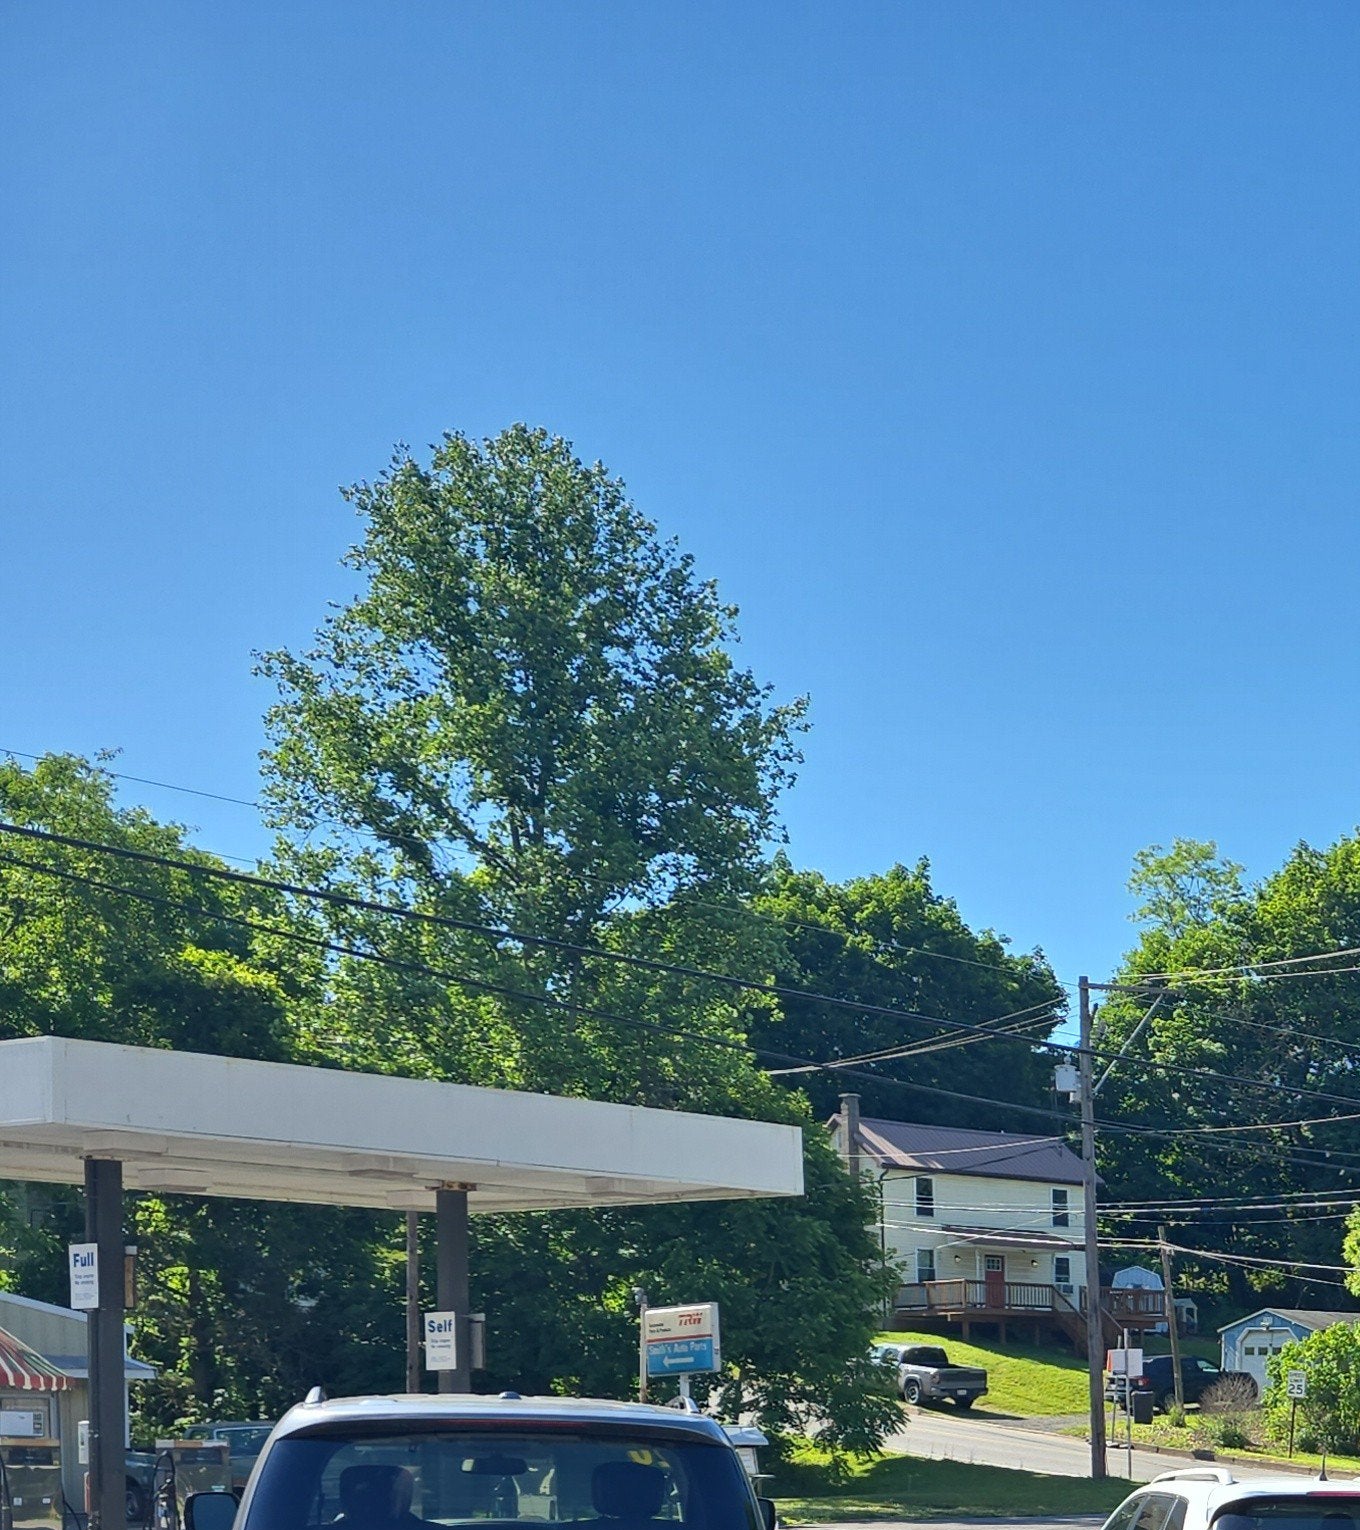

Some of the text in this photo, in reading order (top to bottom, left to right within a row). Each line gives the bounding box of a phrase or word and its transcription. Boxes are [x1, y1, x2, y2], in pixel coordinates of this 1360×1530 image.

[73, 1252, 94, 1267] Full
[428, 1319, 453, 1333] Self
[1288, 1384, 1304, 1395] 25
